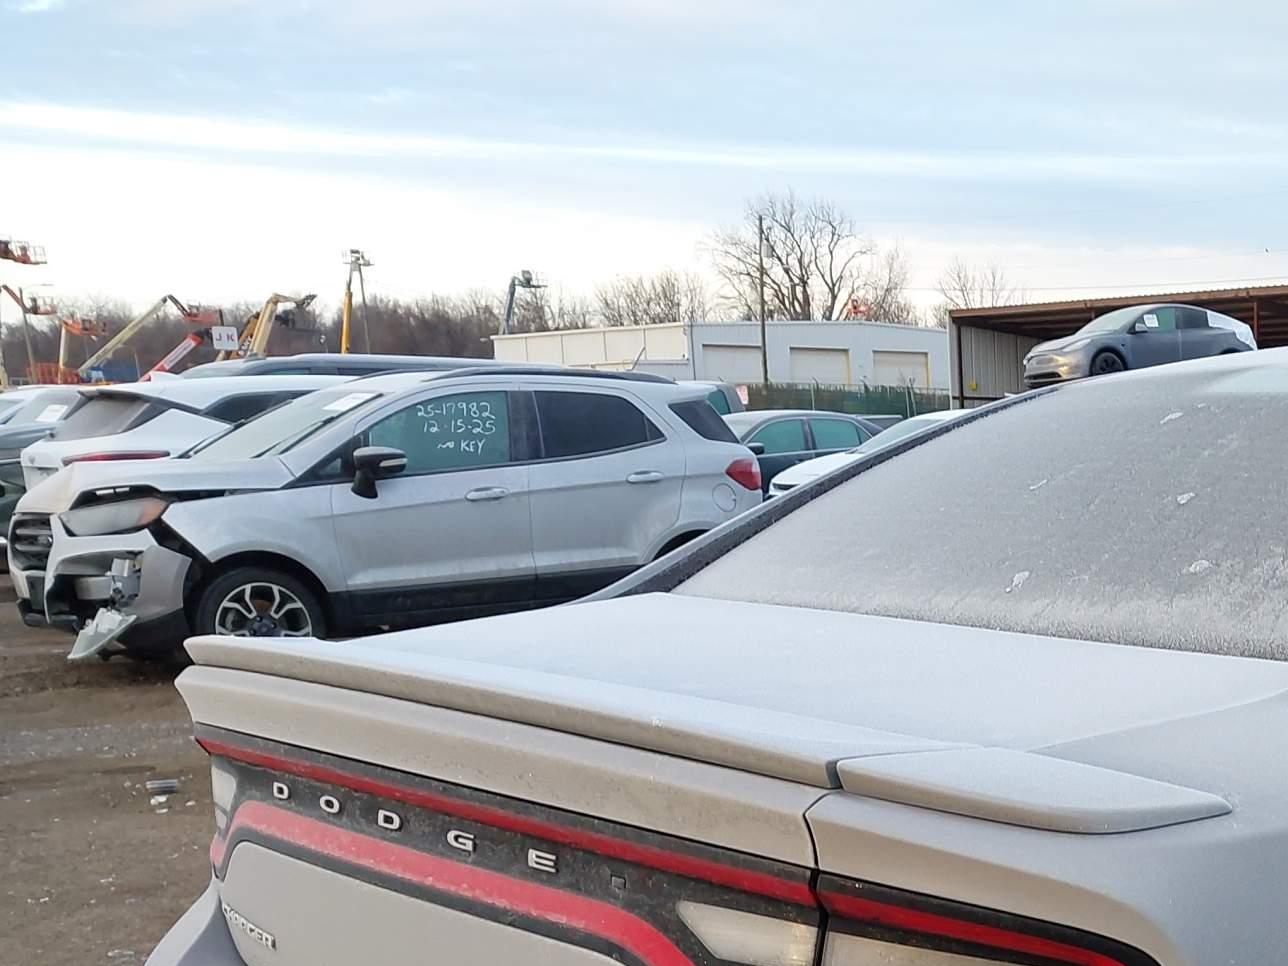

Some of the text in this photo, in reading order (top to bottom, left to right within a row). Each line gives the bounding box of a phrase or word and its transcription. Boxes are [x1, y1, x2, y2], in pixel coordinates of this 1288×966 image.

[416, 402, 496, 419] 25-17982
[460, 438, 486, 455] KEY
[273, 780, 559, 873] DODGE
